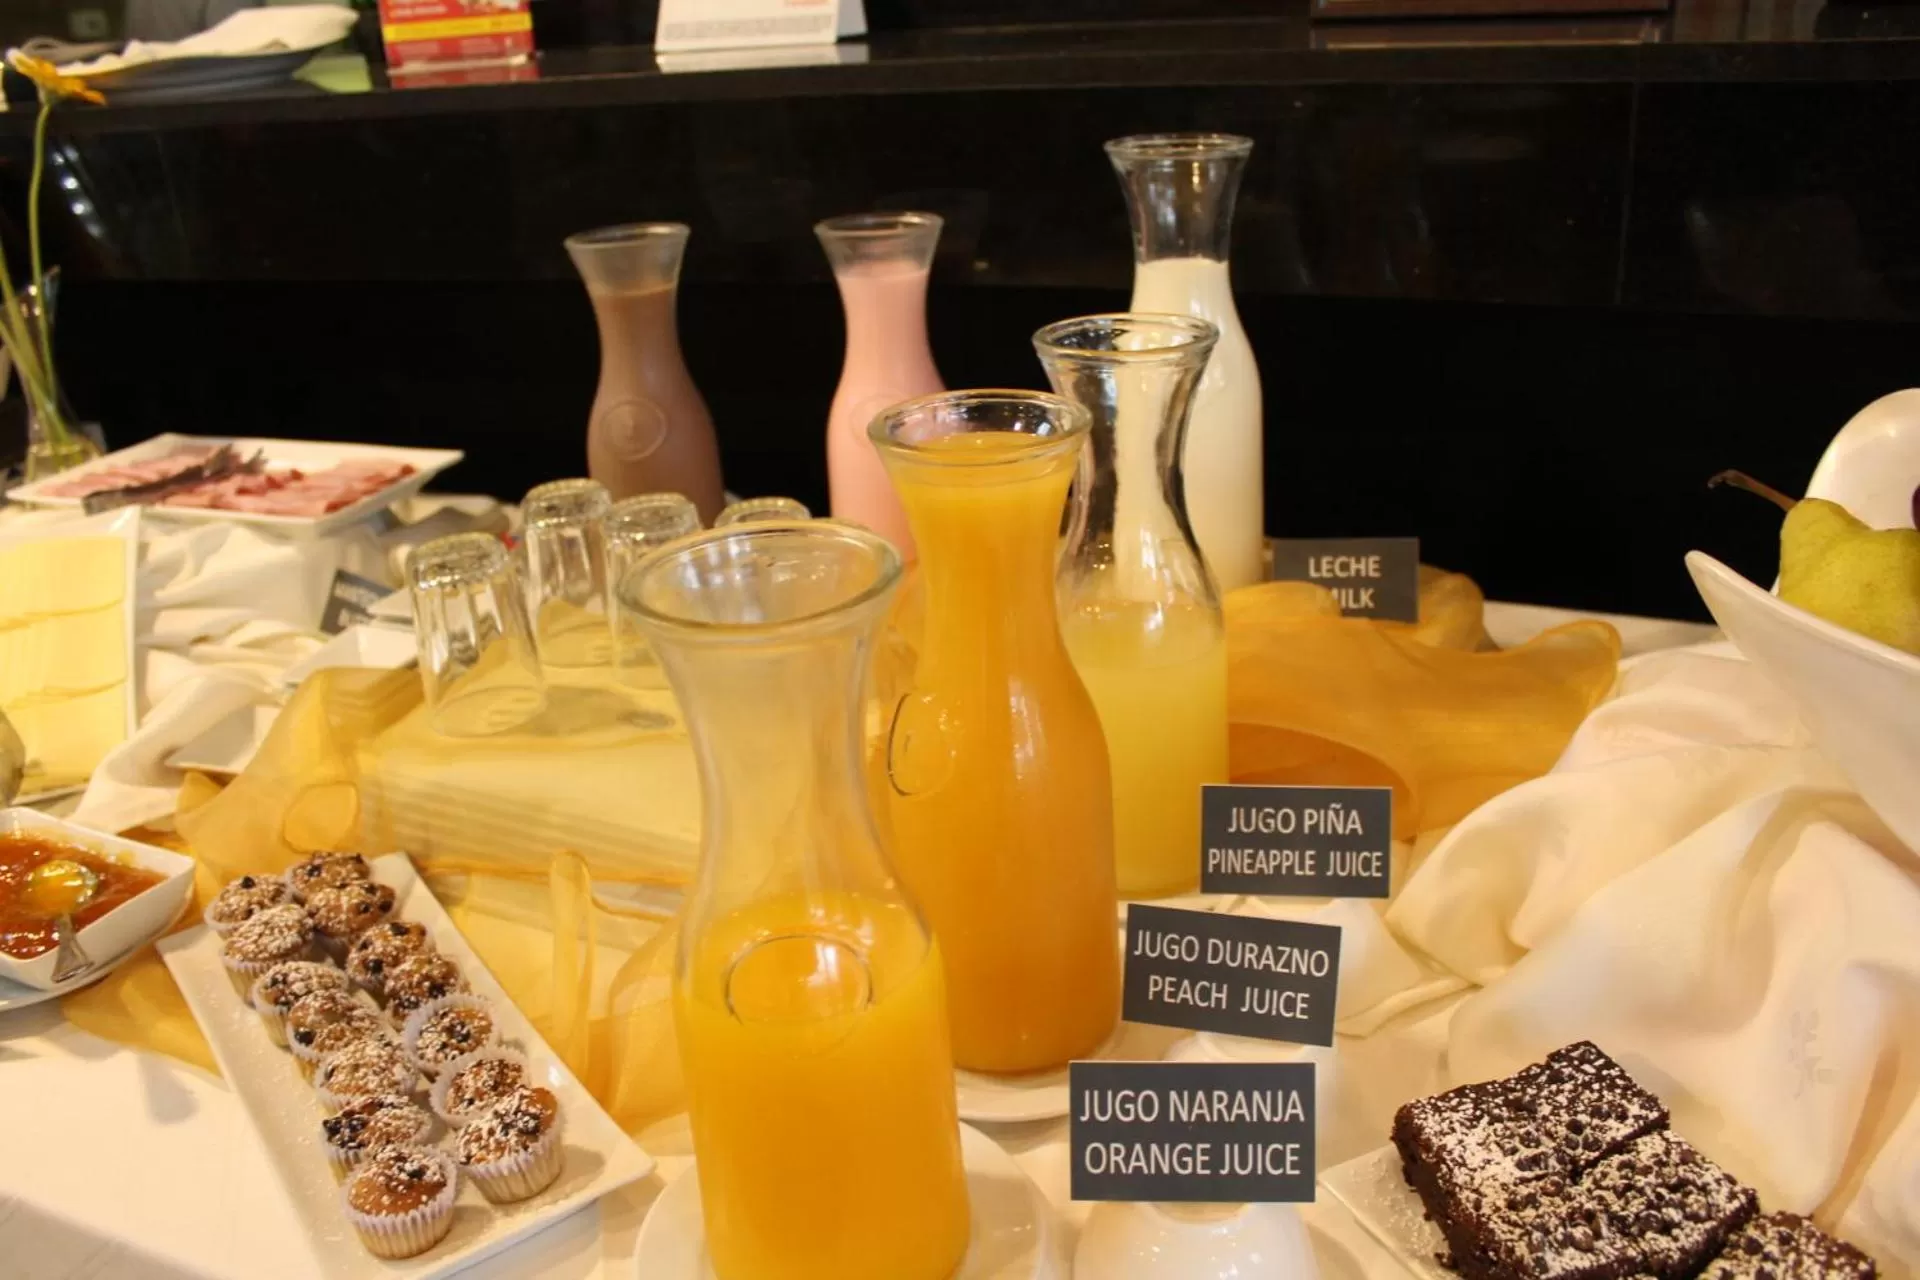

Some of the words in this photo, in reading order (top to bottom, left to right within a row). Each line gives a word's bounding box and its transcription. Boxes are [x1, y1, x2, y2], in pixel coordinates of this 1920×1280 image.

[1308, 556, 1382, 578] LECHE
[1228, 807, 1296, 834] JUGO
[1303, 803, 1363, 836] PIÑA
[1207, 848, 1317, 876] PINEAPPLE
[1326, 851, 1383, 877] JUICE
[1134, 929, 1200, 963] JUGO
[1207, 940, 1329, 978] DURAZNO
[1148, 976, 1228, 1010] PEACH
[1240, 988, 1310, 1020] JUICE
[1080, 1090, 1159, 1122] JUGO
[1169, 1090, 1305, 1123] NARANJA
[1084, 1143, 1211, 1175] ORANGE
[1219, 1144, 1301, 1175] JUICE
